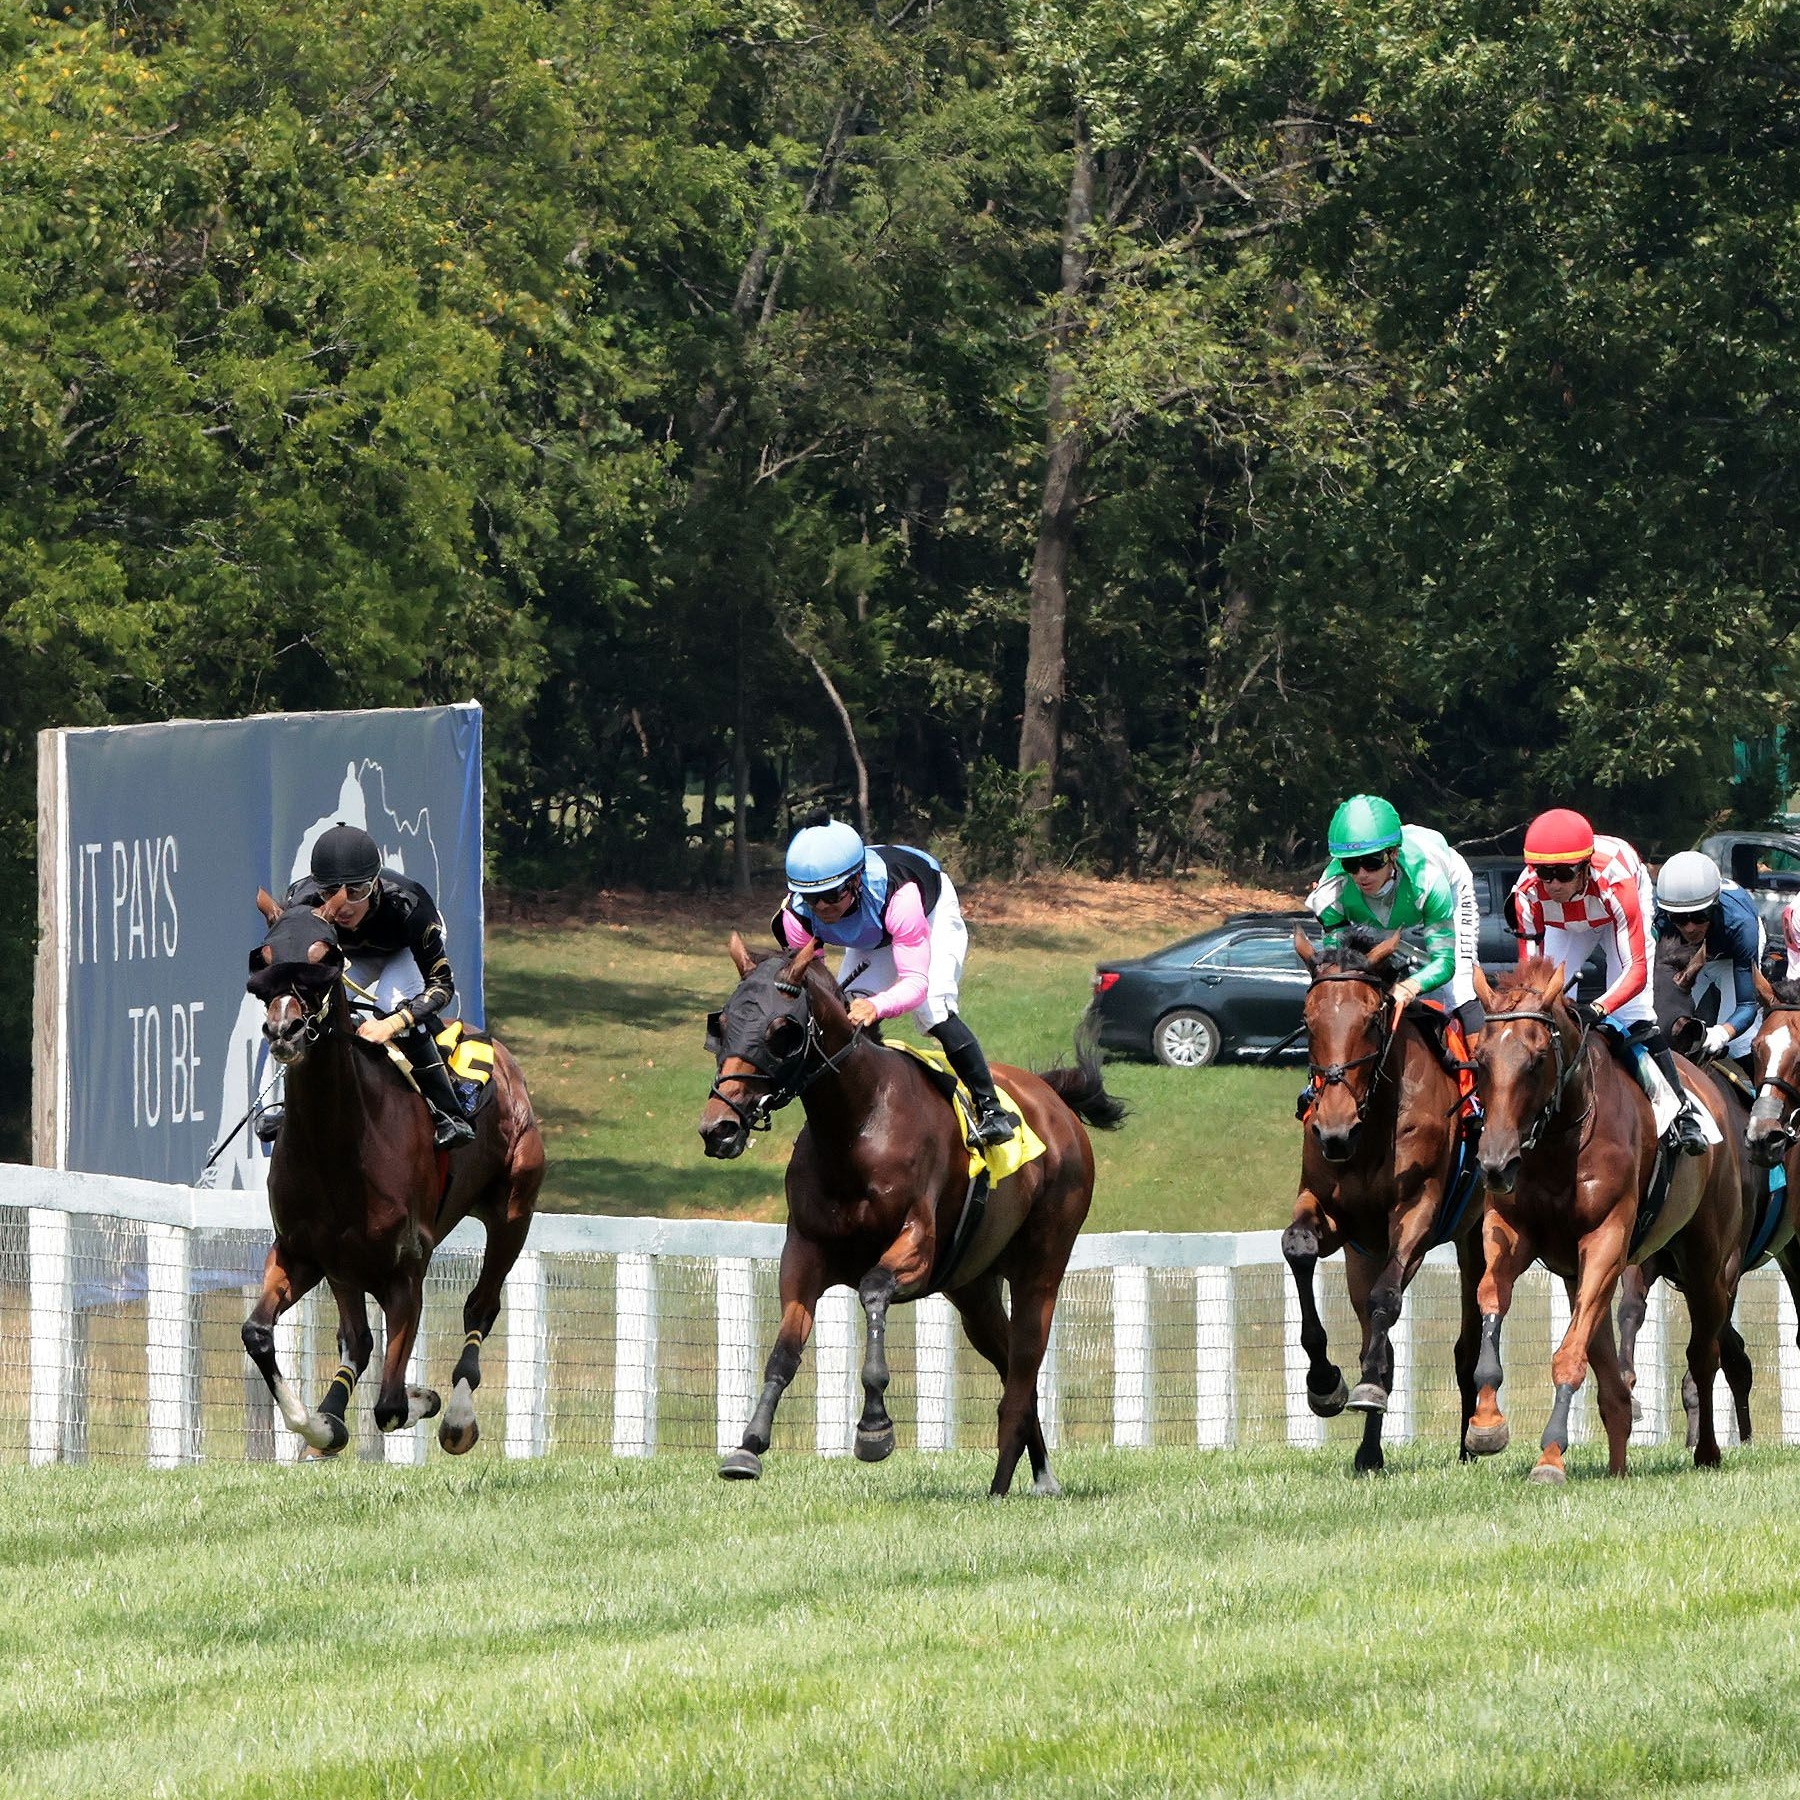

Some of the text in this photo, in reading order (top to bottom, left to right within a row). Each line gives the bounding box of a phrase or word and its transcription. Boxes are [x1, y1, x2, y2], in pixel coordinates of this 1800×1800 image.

[78, 835, 178, 964] IT PAYS
[1460, 931, 1473, 959] JEFF
[128, 1005, 161, 1128] TO
[171, 1001, 205, 1123] BE
